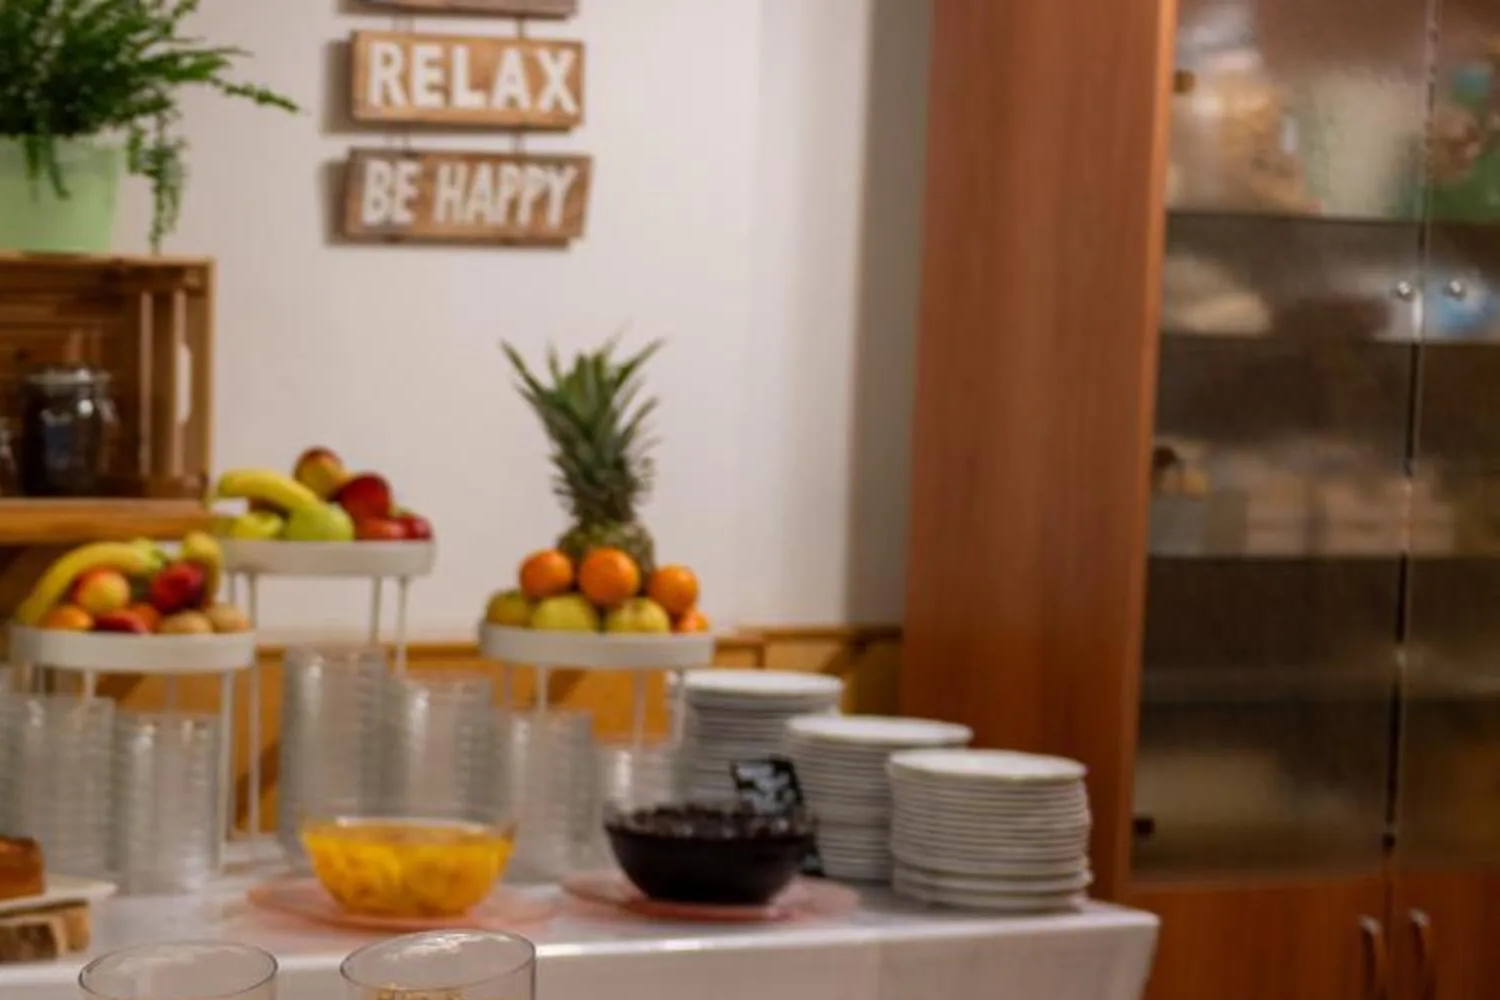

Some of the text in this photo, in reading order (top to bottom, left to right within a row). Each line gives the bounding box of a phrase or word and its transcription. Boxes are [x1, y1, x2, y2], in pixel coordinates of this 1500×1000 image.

[366, 40, 579, 115] RELAX
[360, 158, 578, 229] BE HAPPY
